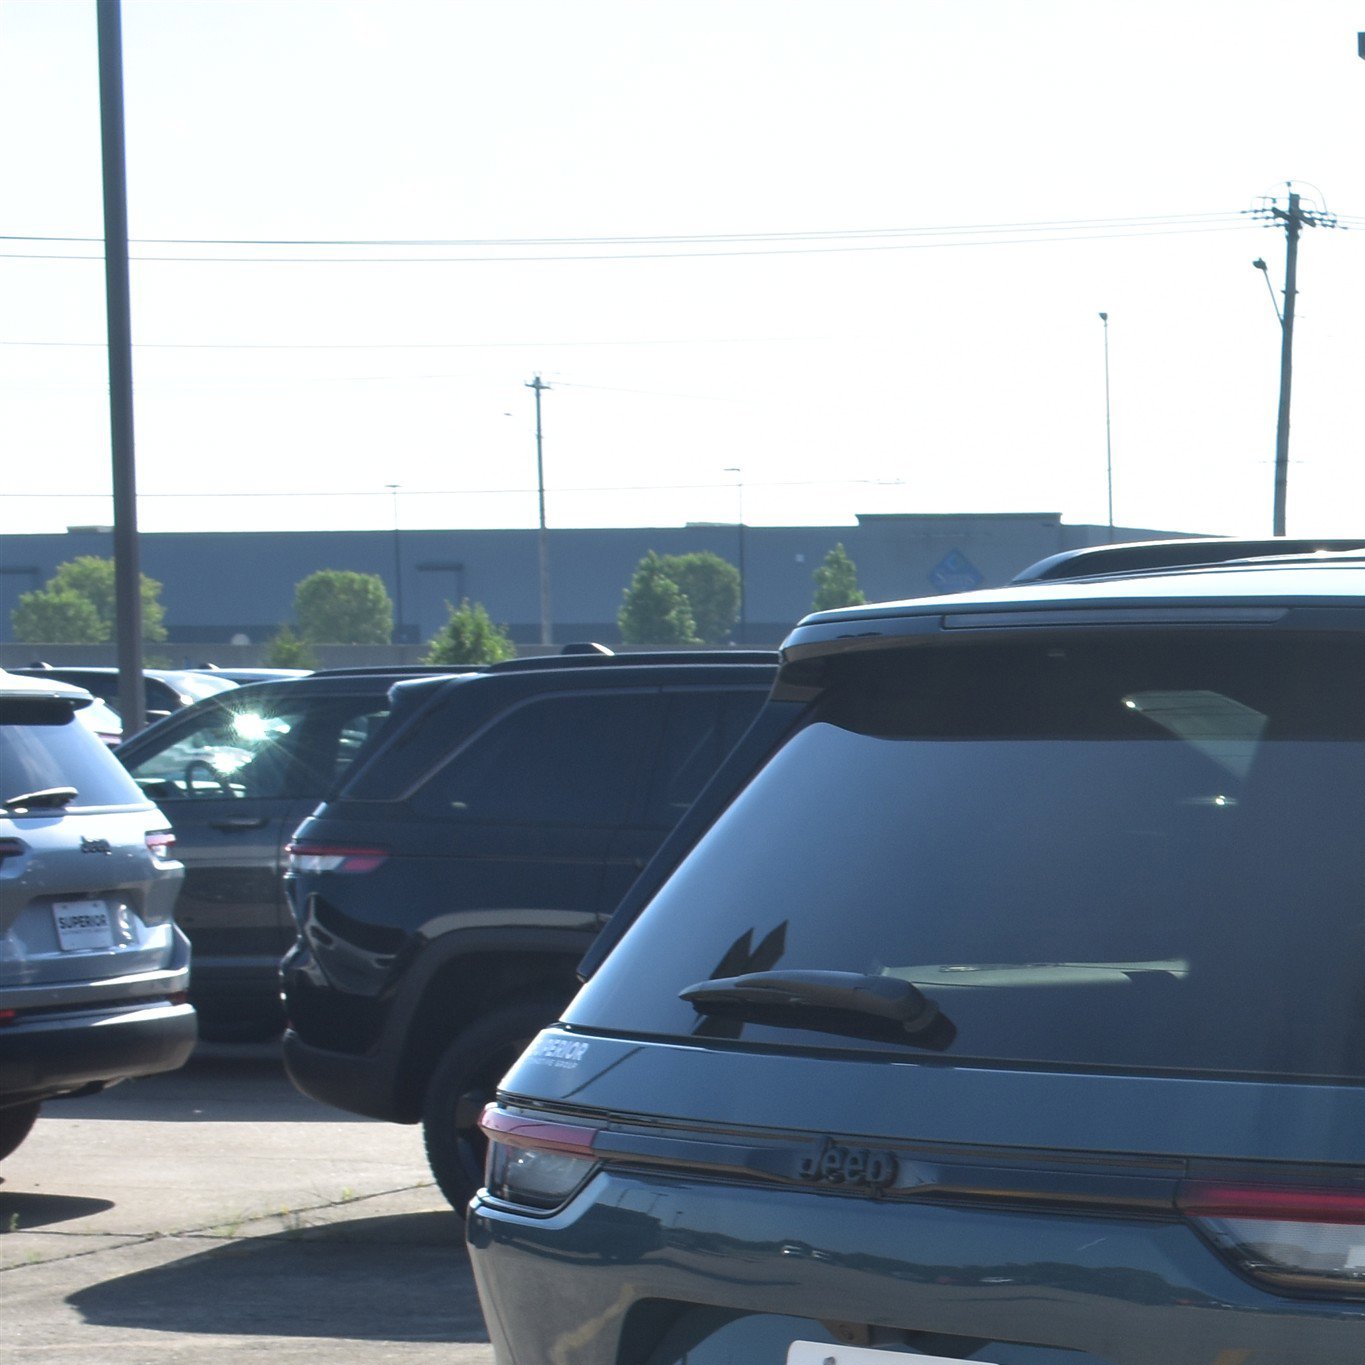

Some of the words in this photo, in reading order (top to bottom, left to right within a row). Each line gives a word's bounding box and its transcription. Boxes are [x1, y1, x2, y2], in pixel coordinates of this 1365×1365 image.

[58, 913, 108, 930] SUPERIOR
[533, 1037, 589, 1061] PERIOR
[799, 1136, 899, 1201] Jeep
